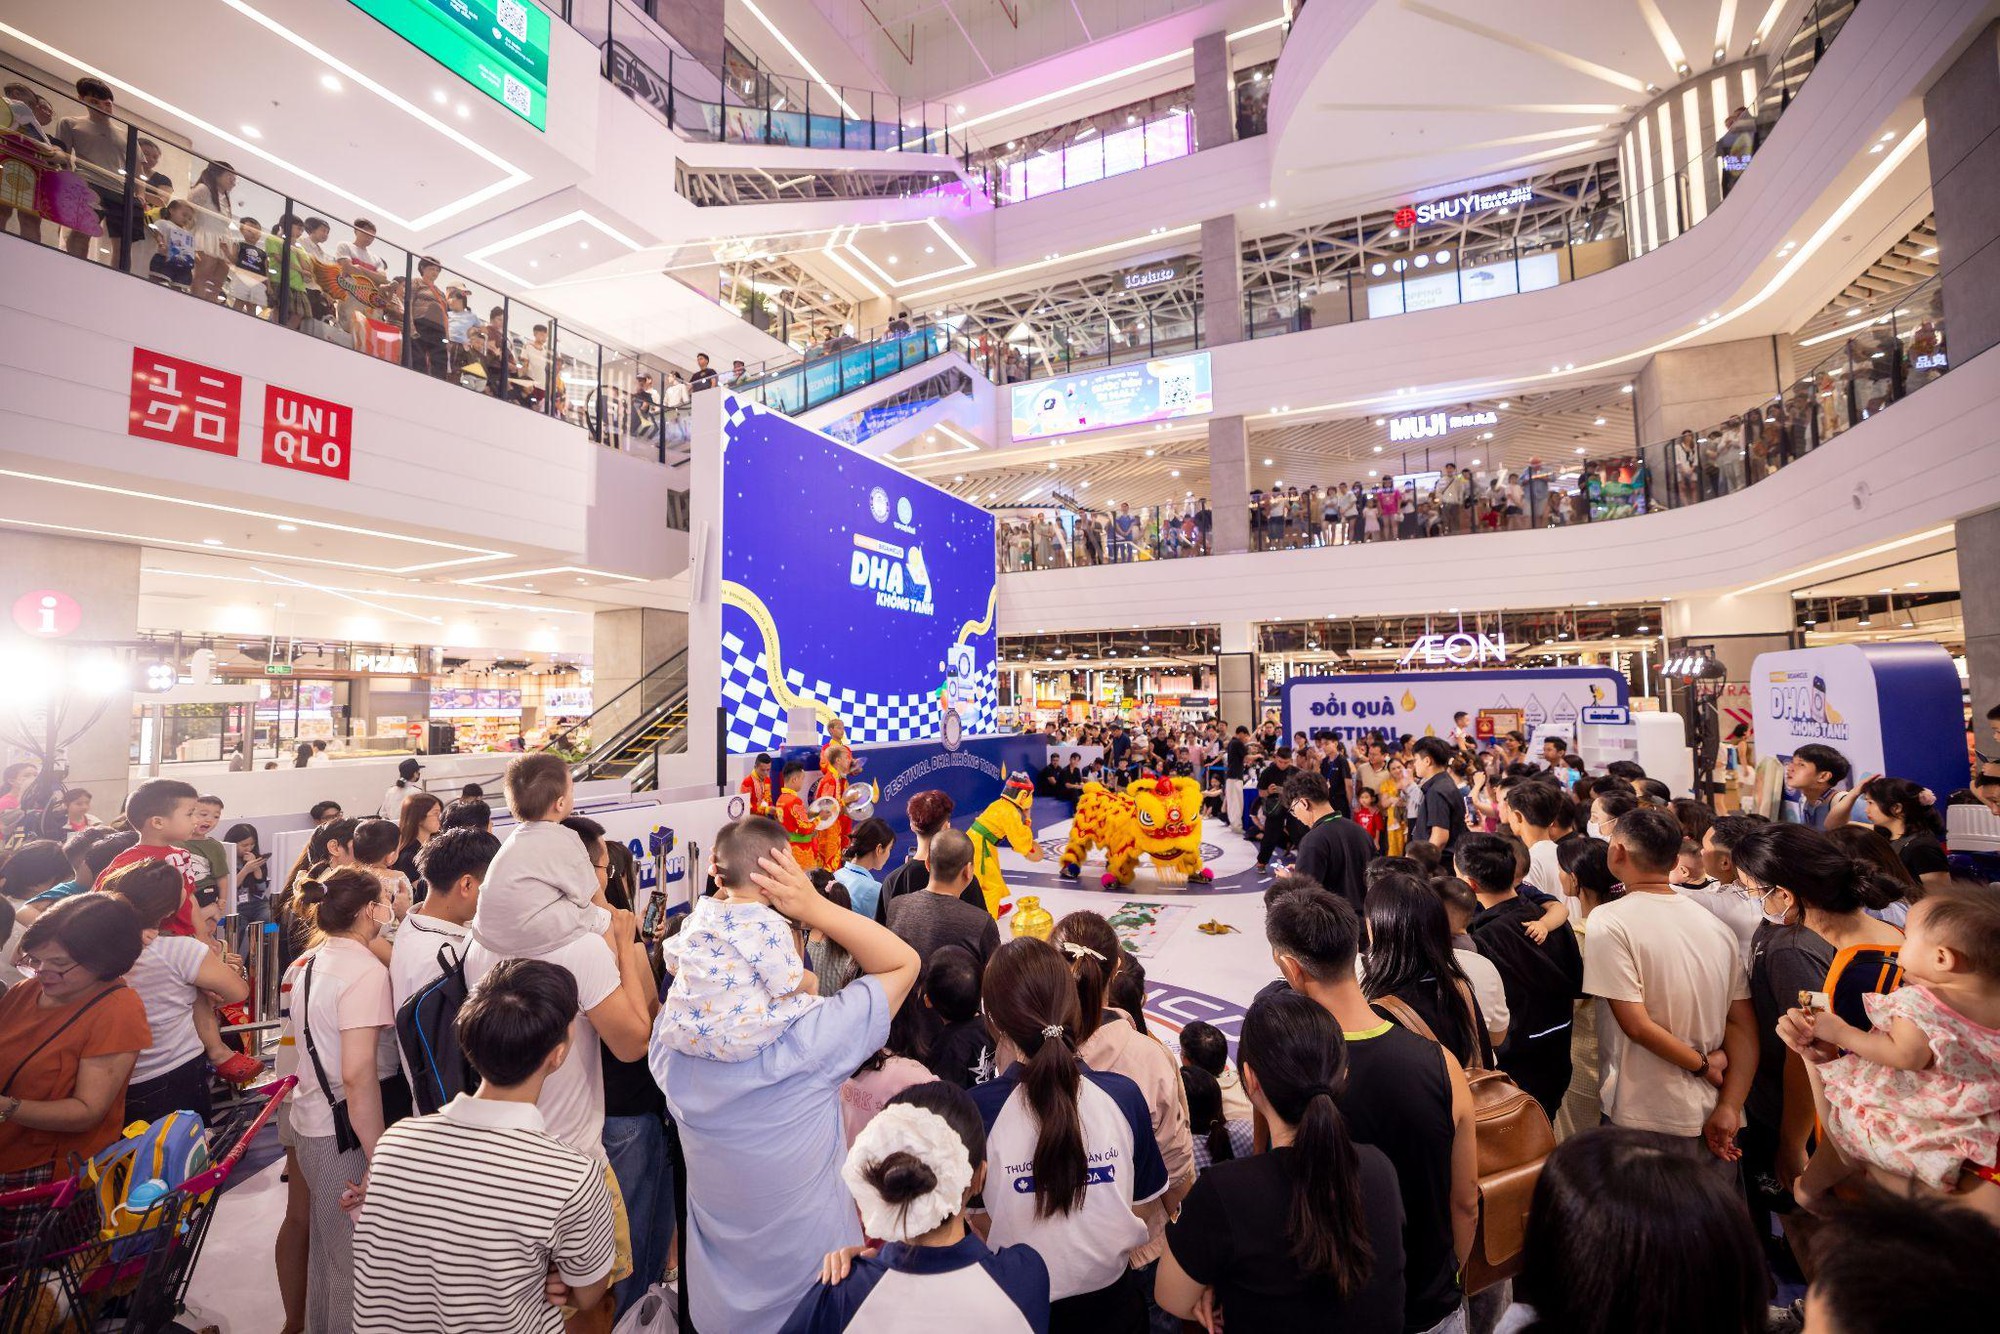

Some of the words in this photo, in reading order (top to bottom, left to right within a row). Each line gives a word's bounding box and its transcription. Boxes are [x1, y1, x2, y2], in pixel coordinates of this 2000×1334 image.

[1417, 194, 1480, 224] SHUYI
[276, 397, 337, 437] UNI
[1390, 412, 1446, 441] MUJI
[273, 431, 341, 468] QLO
[850, 550, 904, 595] DHA
[876, 591, 910, 611] KHÔNG
[909, 598, 935, 616] TANH
[1309, 692, 1346, 716] ĐỔI
[1352, 695, 1395, 718] QUÀ
[1771, 686, 1812, 720] DHA
[1821, 722, 1849, 741] TANH
[883, 759, 932, 802] FESTIVAL
[930, 753, 951, 771] DHA
[950, 749, 980, 769] KHÔNG
[980, 757, 1001, 781] TANH
[1005, 1160, 1034, 1175] THƯƠ
